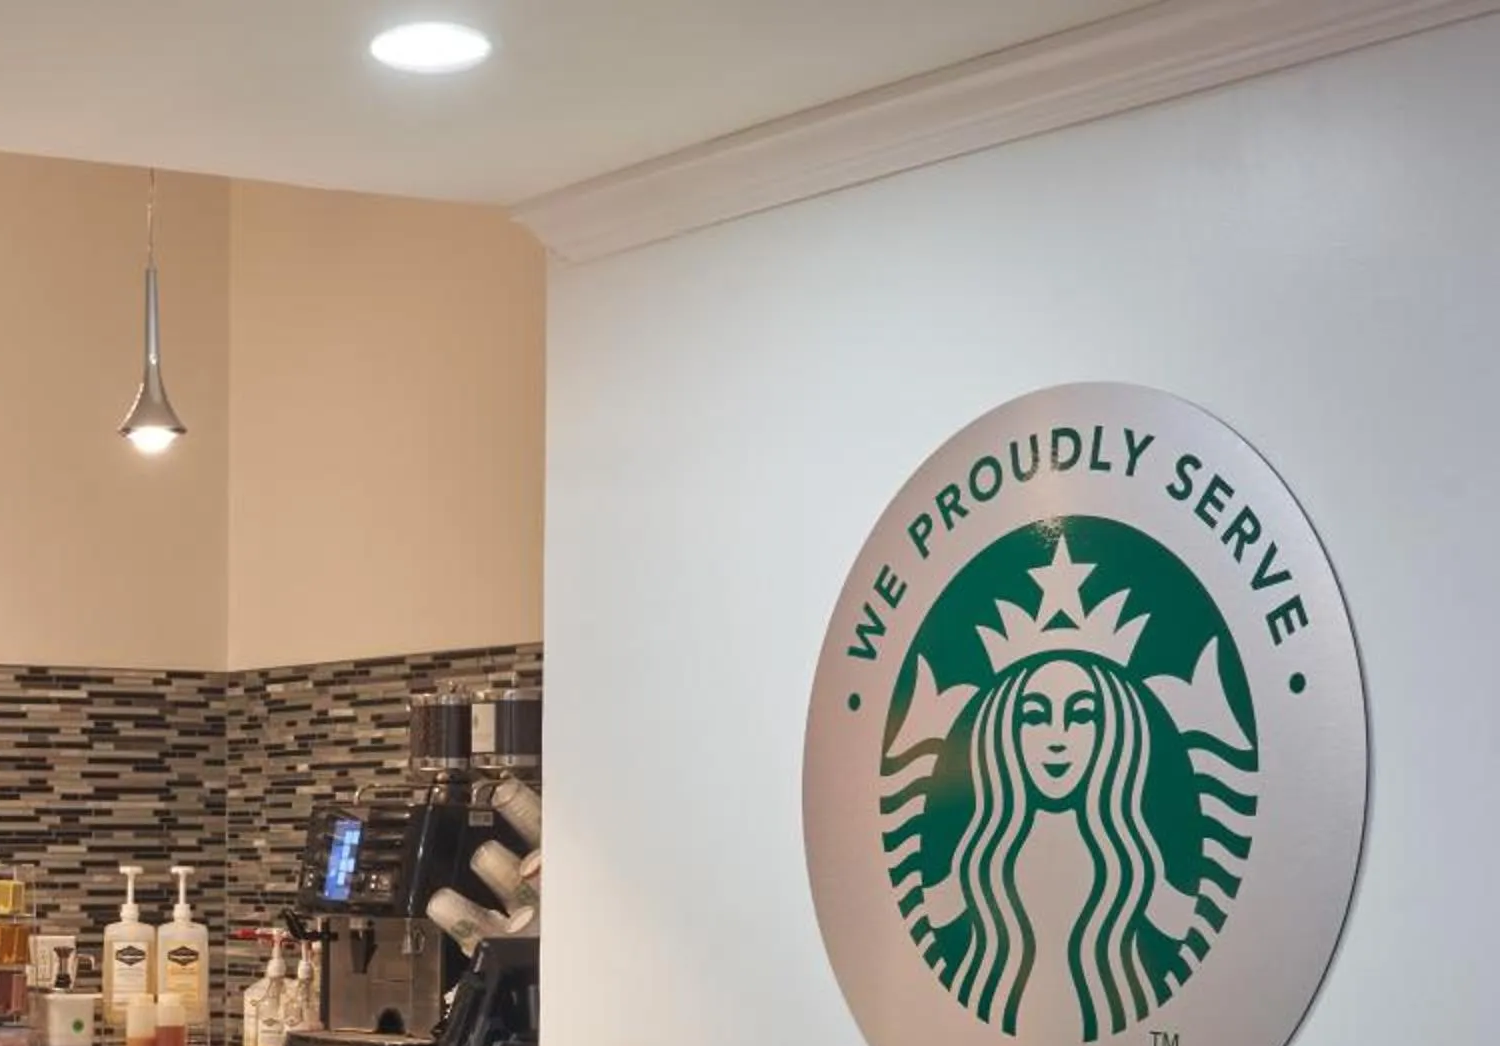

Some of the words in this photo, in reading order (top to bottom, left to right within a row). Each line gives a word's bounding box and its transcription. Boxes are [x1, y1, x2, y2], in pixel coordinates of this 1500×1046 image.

[847, 564, 908, 661] WE
[907, 425, 1156, 560] PROUDLY
[1165, 453, 1310, 646] SERVE
